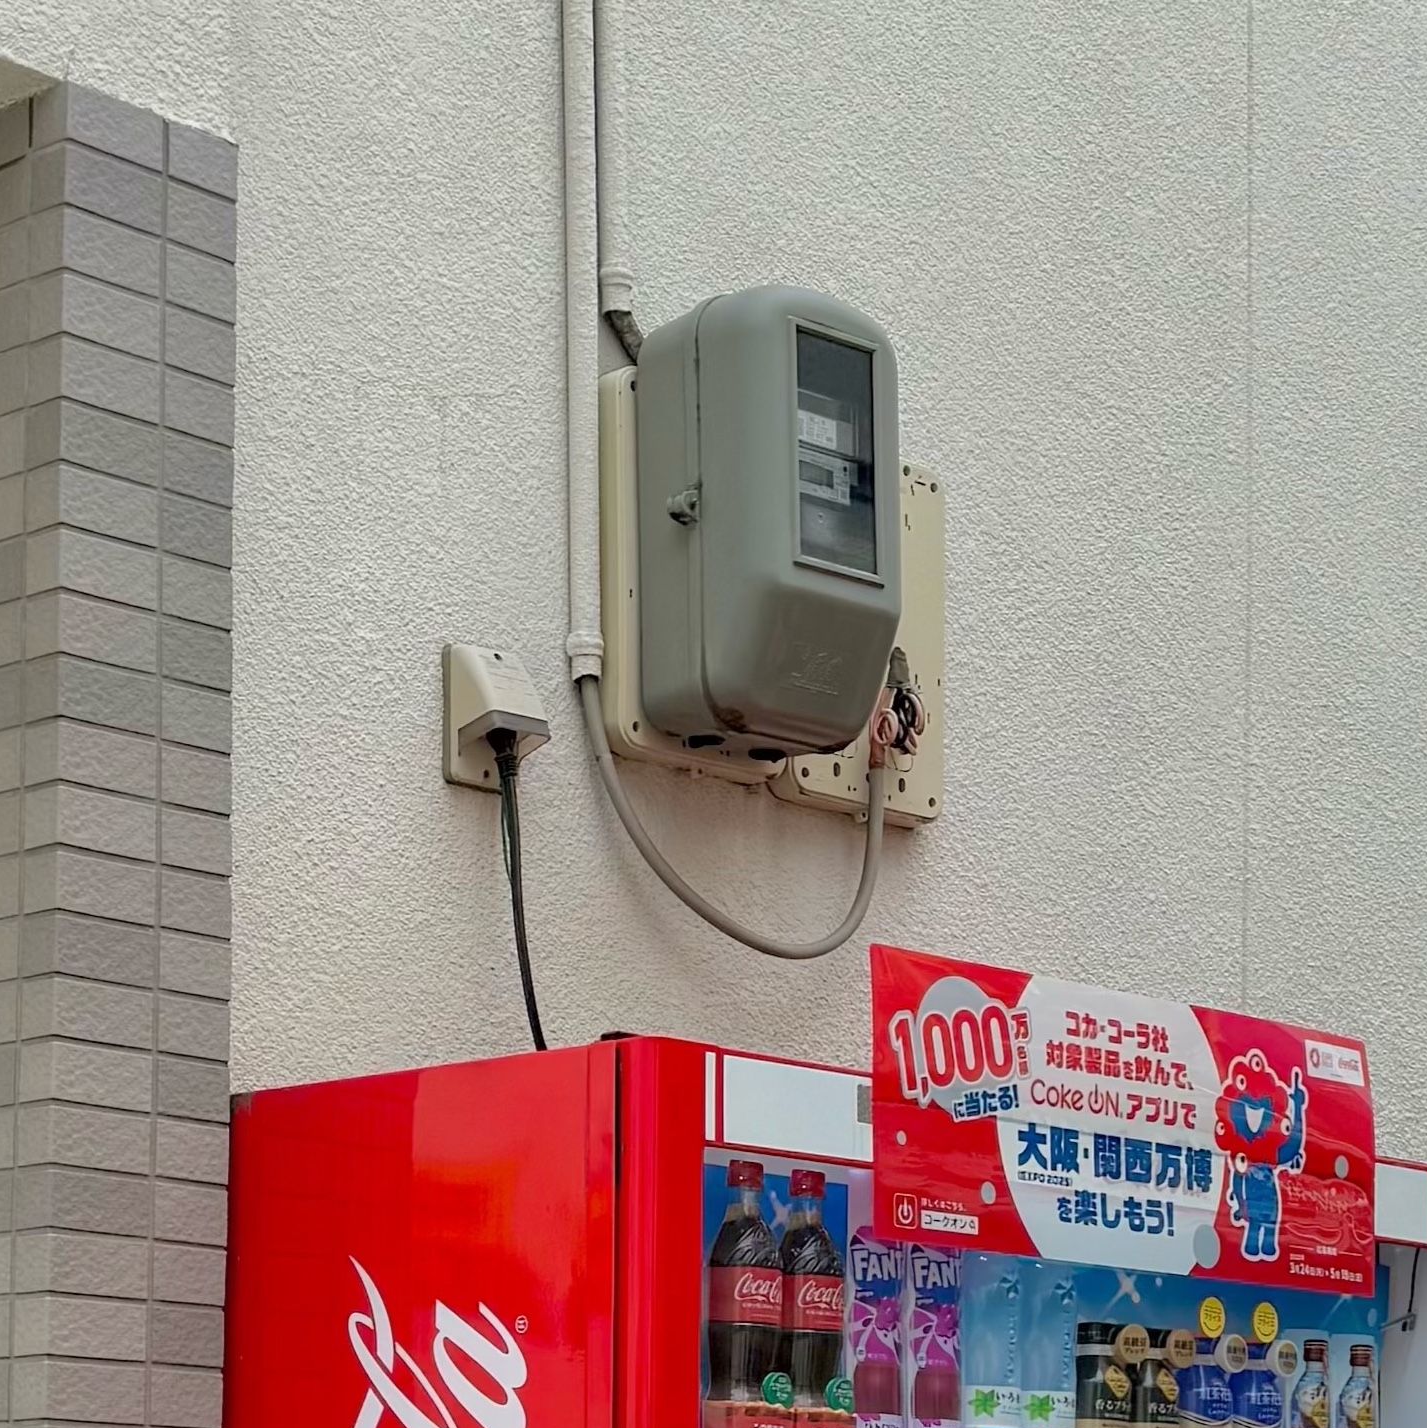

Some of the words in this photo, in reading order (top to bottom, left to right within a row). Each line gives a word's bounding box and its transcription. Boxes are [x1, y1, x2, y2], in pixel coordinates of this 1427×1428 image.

[893, 1005, 1013, 1099] 1,000
[1065, 1011, 1169, 1054] コカ・コーラ社
[1046, 1039, 1195, 1091] 対象製品を飲んで、
[953, 1084, 1019, 1119] に当たる!
[1031, 1079, 1084, 1112] Coke
[1126, 1093, 1197, 1130] アプリで
[1018, 1122, 1213, 1193] 大阪・関西万博
[924, 1213, 967, 1229] コークオン
[1057, 1190, 1175, 1237] を楽しもう!
